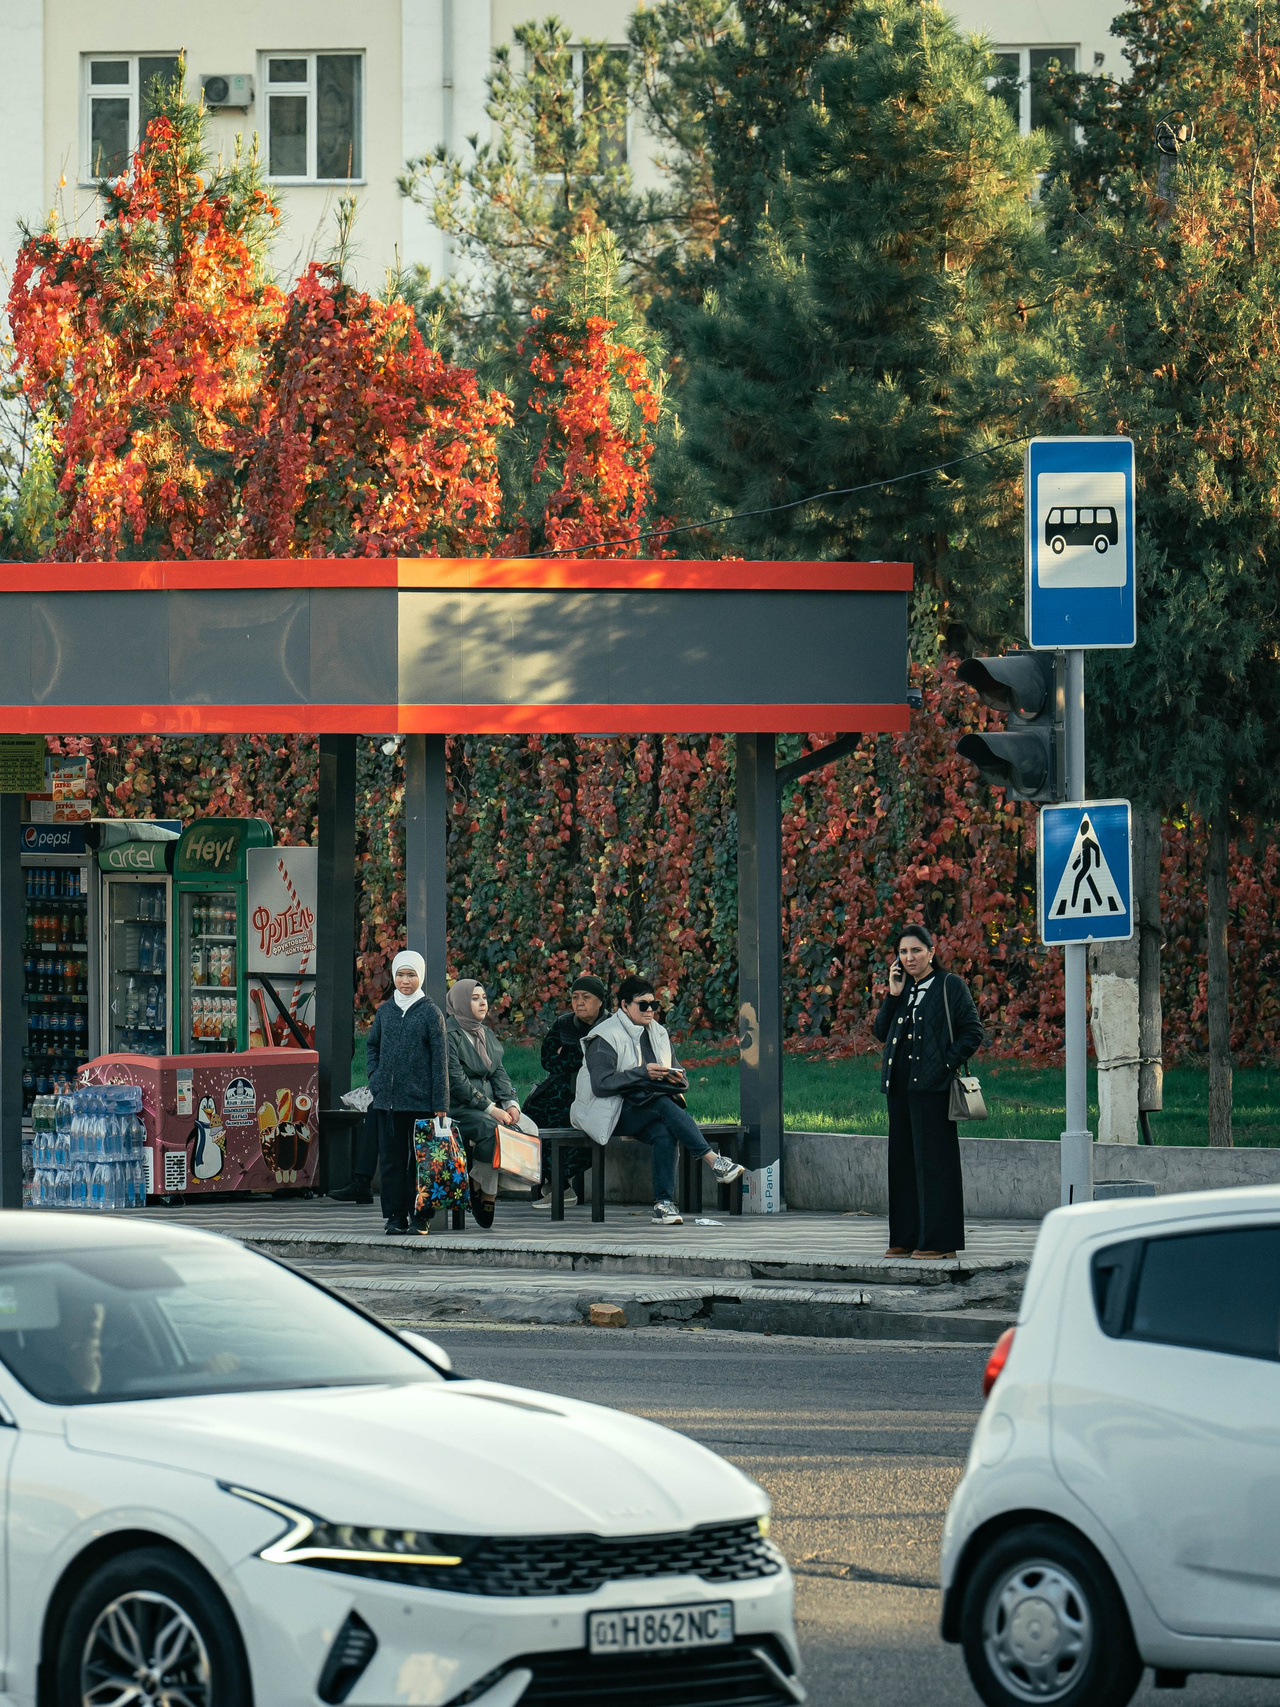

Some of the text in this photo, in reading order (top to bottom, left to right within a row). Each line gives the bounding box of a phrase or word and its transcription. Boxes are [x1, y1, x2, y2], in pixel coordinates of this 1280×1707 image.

[38, 831, 71, 847] pepsi
[185, 835, 235, 868] Hey!
[108, 845, 156, 869] artel
[622, 1609, 719, 1646] H862NC
